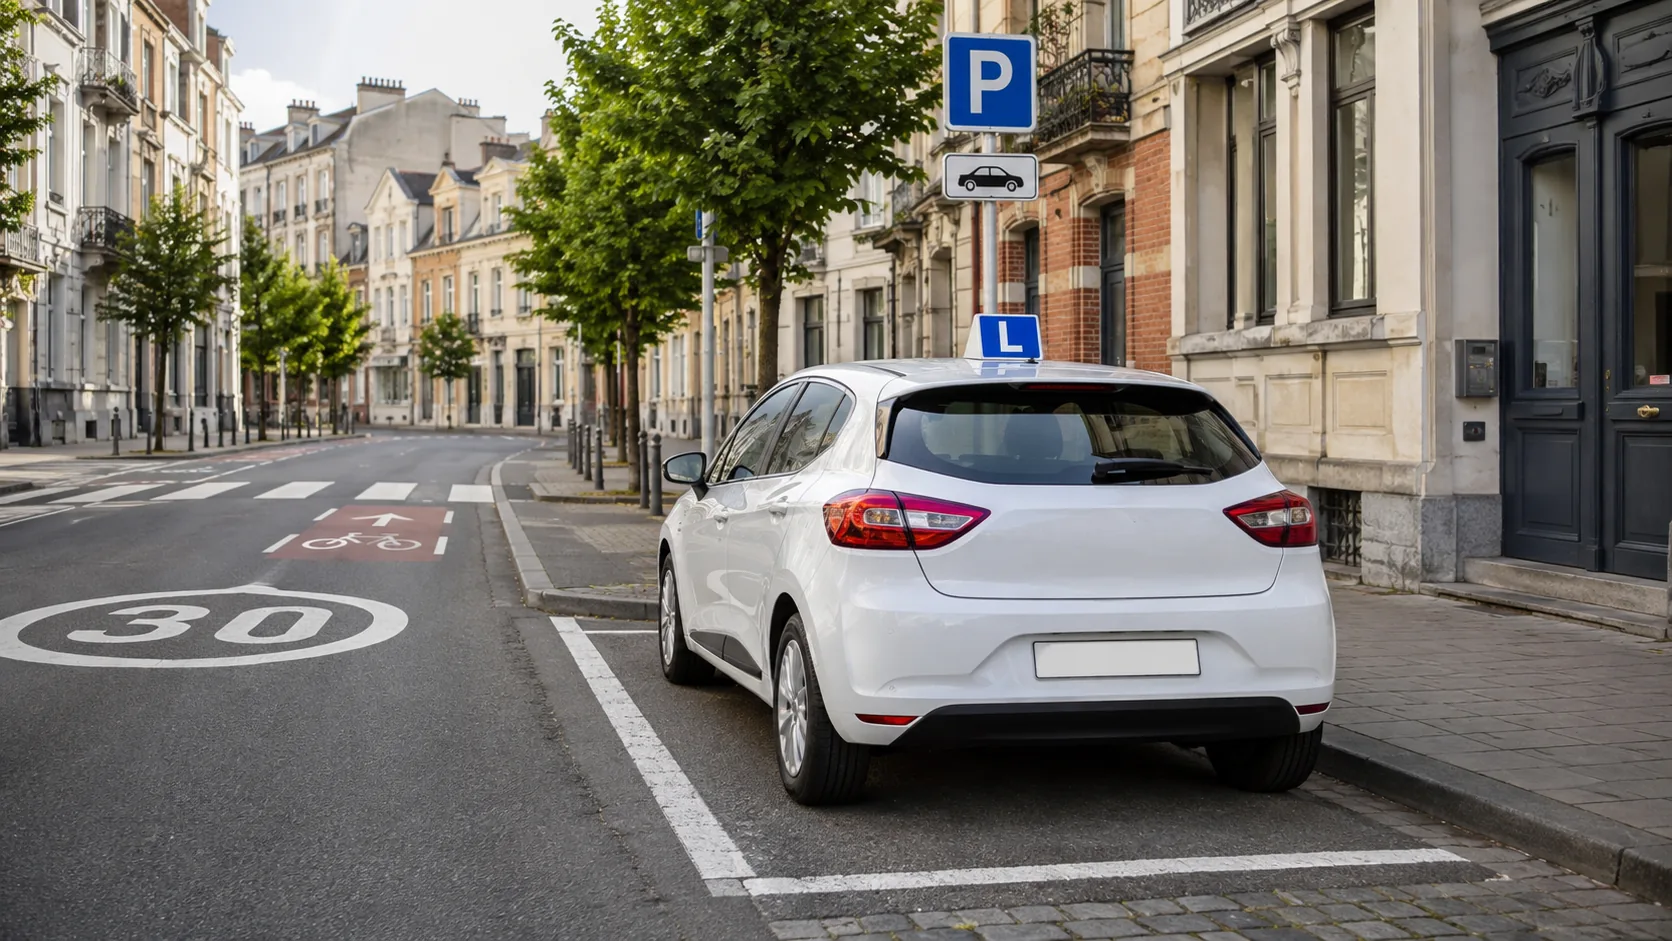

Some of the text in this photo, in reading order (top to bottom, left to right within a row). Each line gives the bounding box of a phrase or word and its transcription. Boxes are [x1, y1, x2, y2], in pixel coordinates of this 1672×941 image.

[969, 49, 1013, 114] P
[998, 320, 1023, 353] L
[66, 604, 334, 645] 30
